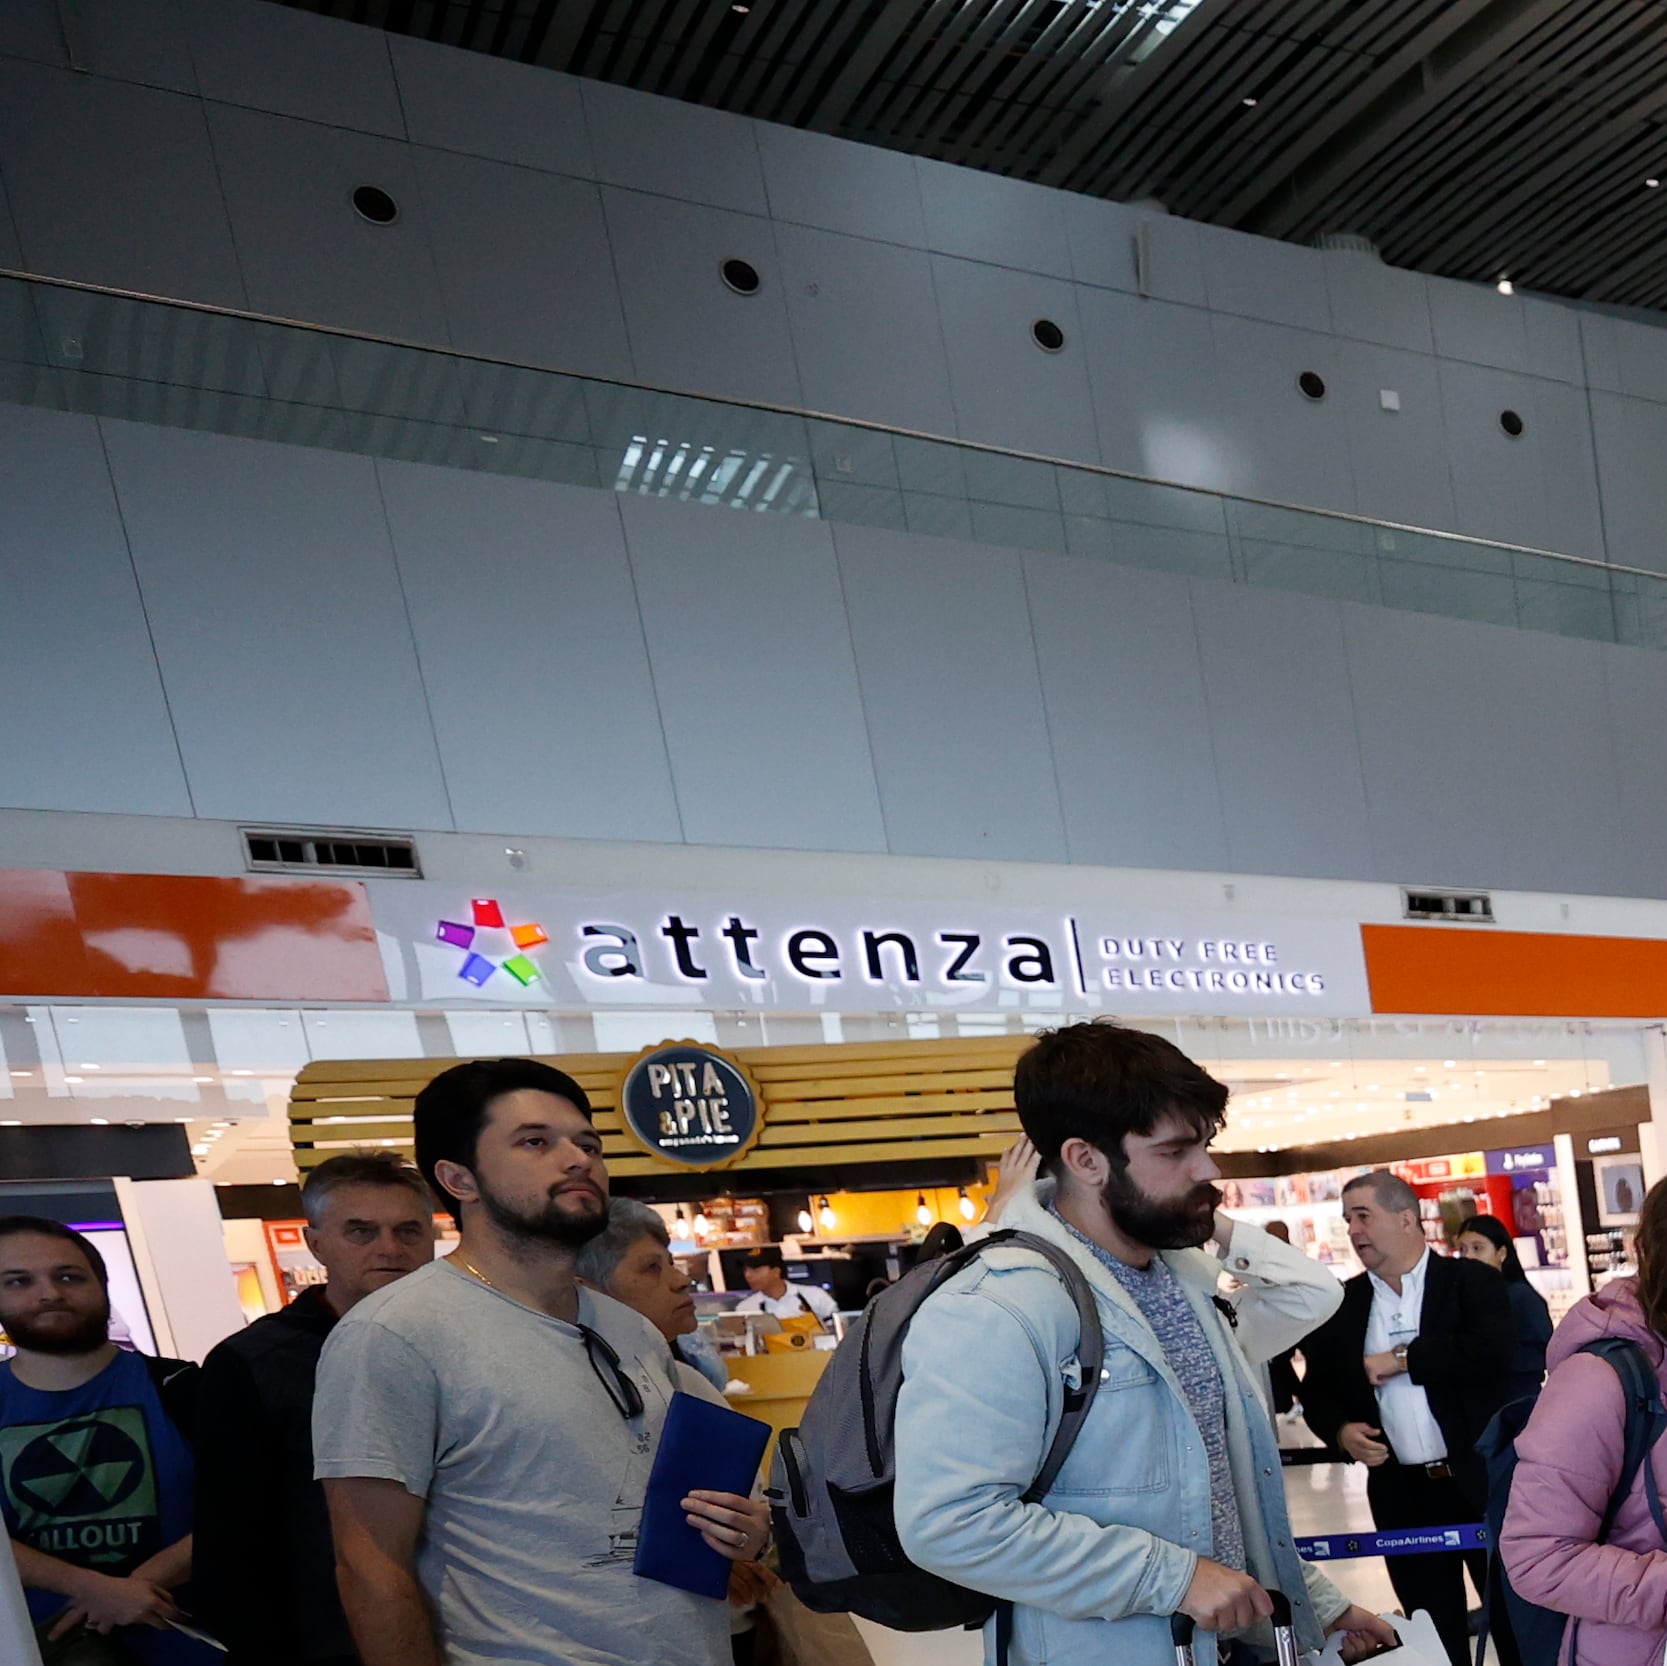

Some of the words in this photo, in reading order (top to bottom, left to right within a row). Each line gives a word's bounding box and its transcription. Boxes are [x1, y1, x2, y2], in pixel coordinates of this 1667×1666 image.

[582, 914, 1056, 985] attenza
[1103, 937, 1186, 959] DUTY
[1204, 941, 1279, 961] FREE
[1107, 968, 1326, 992] ELECTRONICS
[648, 1062, 725, 1098] PITA
[30, 1521, 142, 1551] ALLOUT
[1376, 1534, 1444, 1548] CopaAirlines
